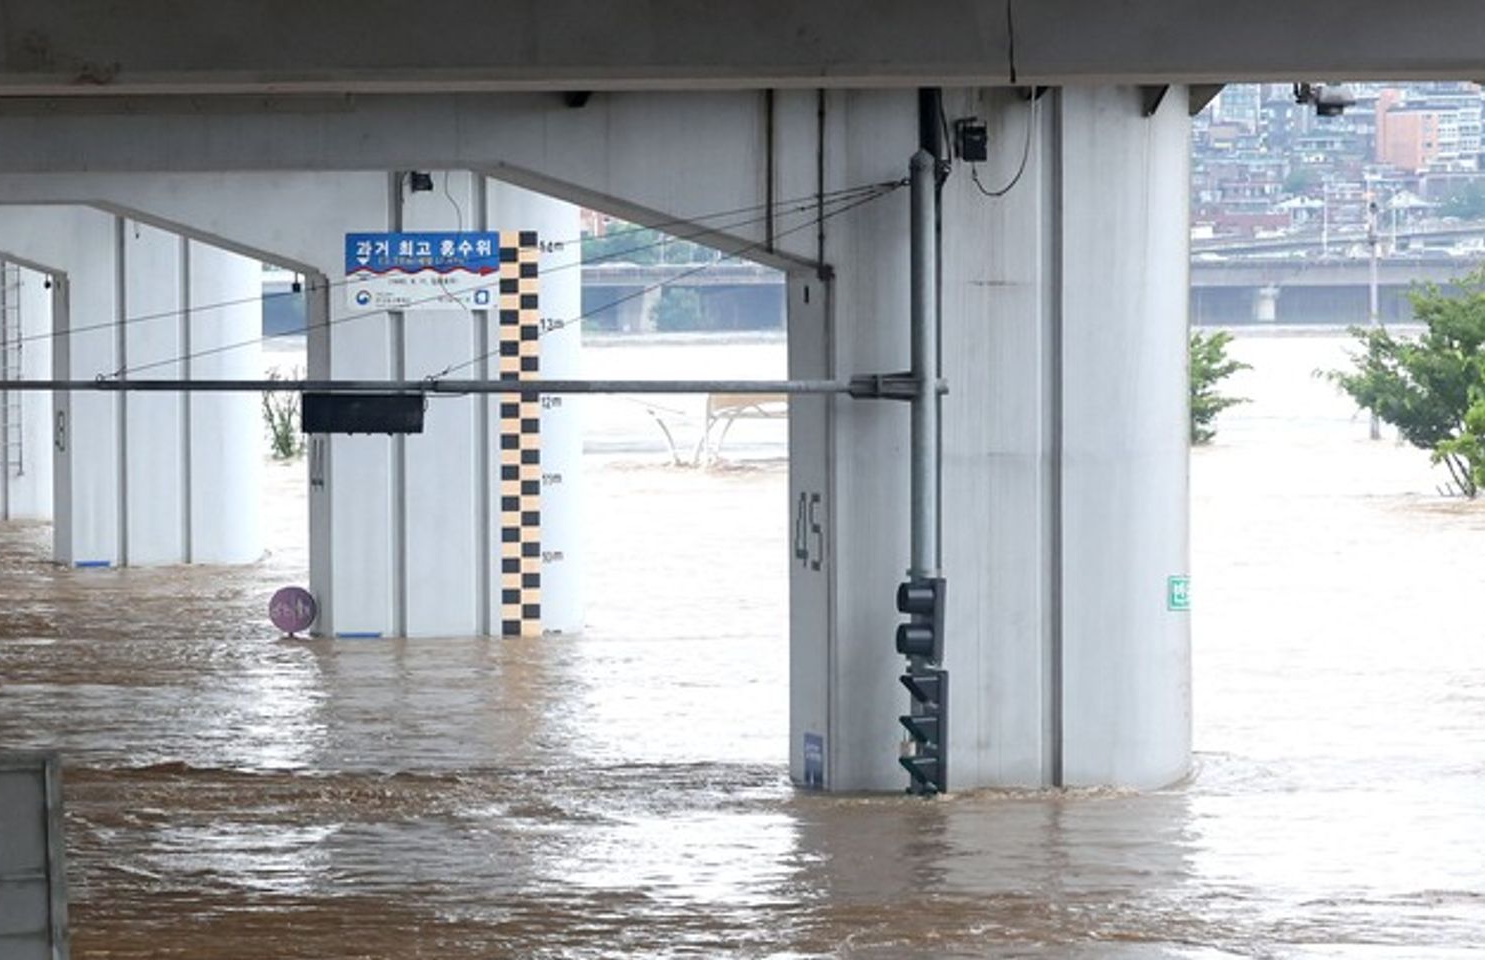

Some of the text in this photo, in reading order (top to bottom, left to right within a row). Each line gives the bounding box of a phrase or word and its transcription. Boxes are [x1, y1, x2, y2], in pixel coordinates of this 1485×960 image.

[355, 239, 492, 257] 과거 최고 홍수위
[795, 491, 824, 572] 45
